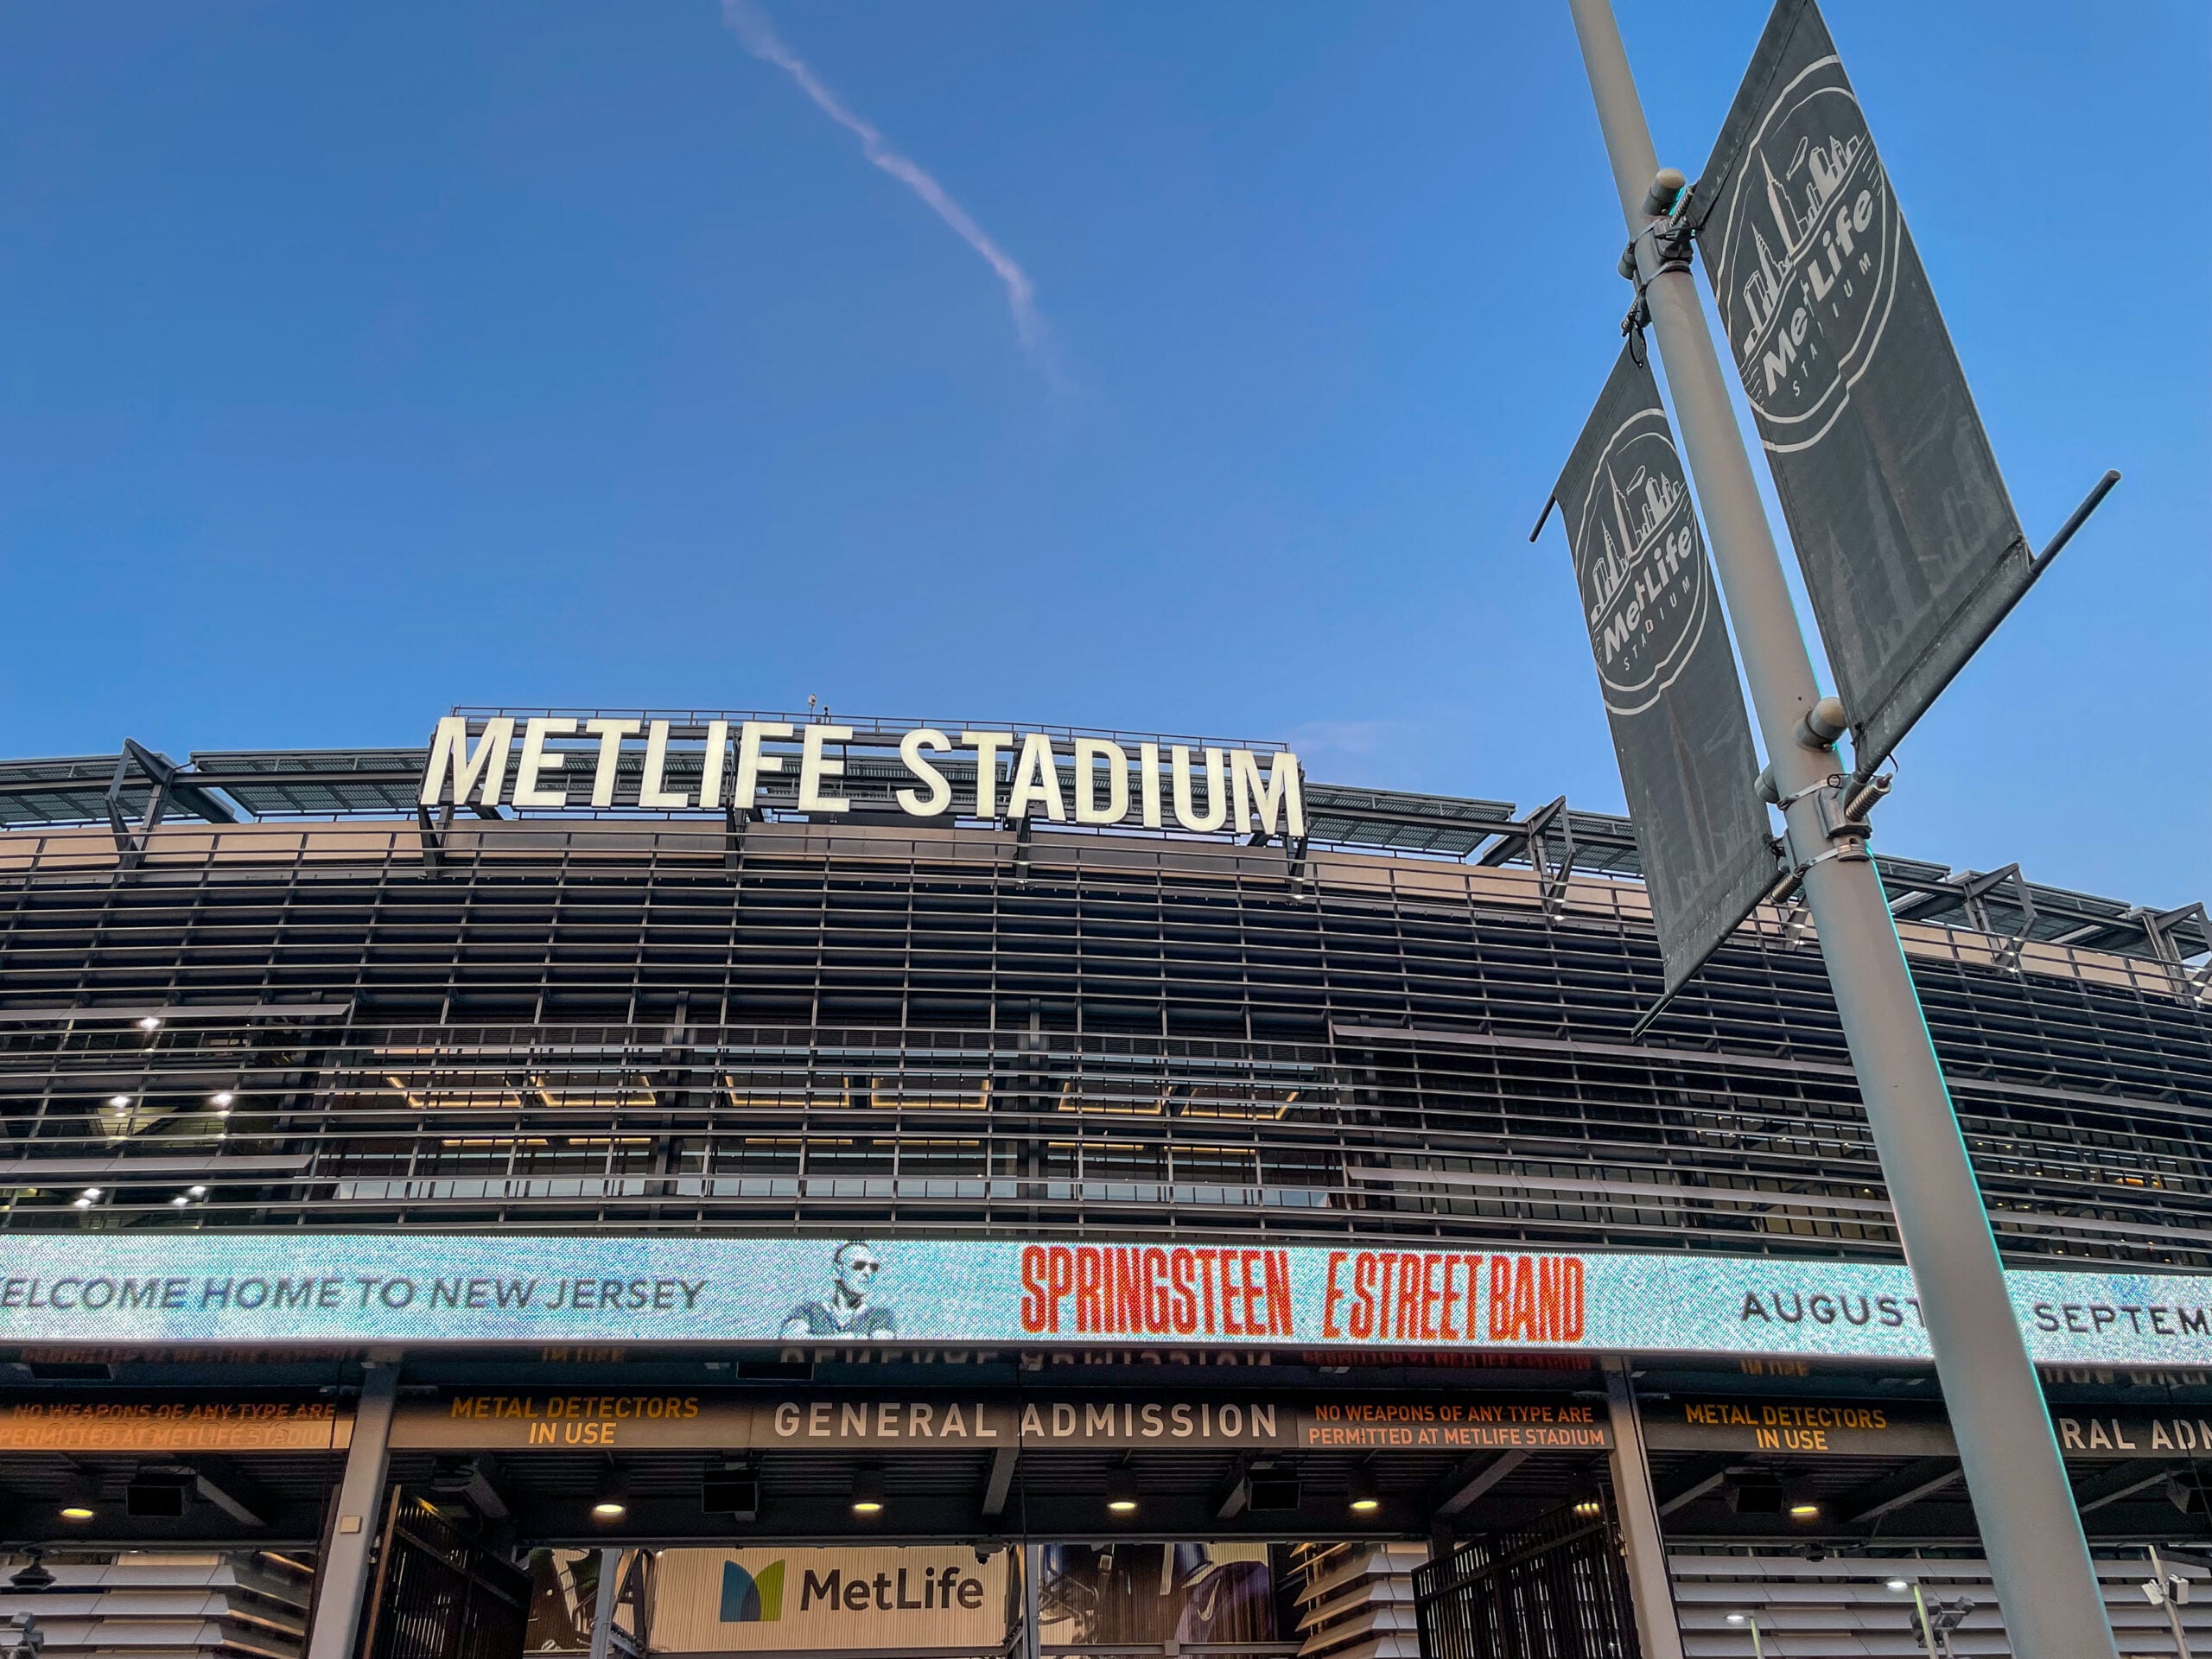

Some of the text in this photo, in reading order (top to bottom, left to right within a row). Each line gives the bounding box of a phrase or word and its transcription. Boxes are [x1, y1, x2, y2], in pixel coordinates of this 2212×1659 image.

[1763, 188, 1873, 397] MetLife
[1604, 525, 1693, 665] MetLife
[1623, 575, 1691, 671] STADIUM
[420, 716, 1305, 837] METLIFE STADIUM
[0, 1276, 709, 1311] ELCOME HOME TO NEW JERSEY
[1020, 1244, 1586, 1343] SPRINGSTEEN E STREET BAND
[2033, 1301, 2212, 1336] SEPTEM
[48, 1404, 153, 1420] WEAPONS
[238, 1404, 291, 1420] TYPE
[295, 1404, 336, 1420] ARE
[451, 1395, 700, 1419] METAL DETECTORS
[773, 1402, 1278, 1439] GENERAL ADMISSION
[1315, 1405, 1594, 1423] NO WEAPONS OF ANY TYPE ARE
[1685, 1402, 1887, 1429] METAL DETECTORS
[528, 1422, 617, 1445] IN USE
[1308, 1427, 1605, 1446] PERMITTED AT METLIFE STADIUM
[1756, 1428, 1829, 1452] IN USE
[800, 1567, 985, 1611] MetLife
